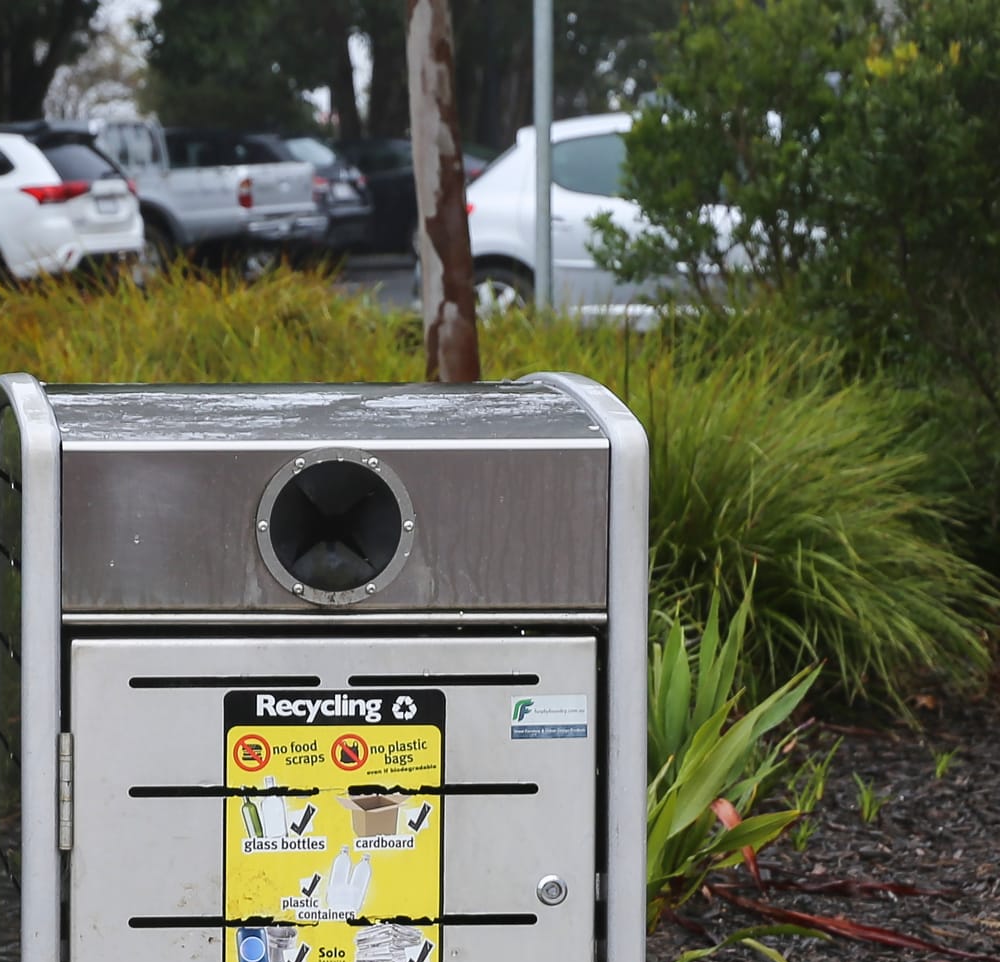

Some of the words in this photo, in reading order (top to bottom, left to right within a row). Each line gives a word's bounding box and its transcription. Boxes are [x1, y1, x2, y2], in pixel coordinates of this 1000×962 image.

[256, 694, 382, 723] Recycling
[272, 744, 287, 755] no
[290, 740, 317, 753] food
[370, 744, 385, 754] no
[388, 739, 428, 755] plastic
[285, 754, 325, 766] scraps
[384, 753, 414, 766] bags
[390, 764, 437, 773] biodegradable
[244, 838, 277, 852] glass
[281, 838, 325, 850] bottles
[355, 837, 414, 848] cardboard
[282, 898, 318, 910] plastic
[298, 910, 355, 920] containers
[318, 947, 345, 957] Solo
